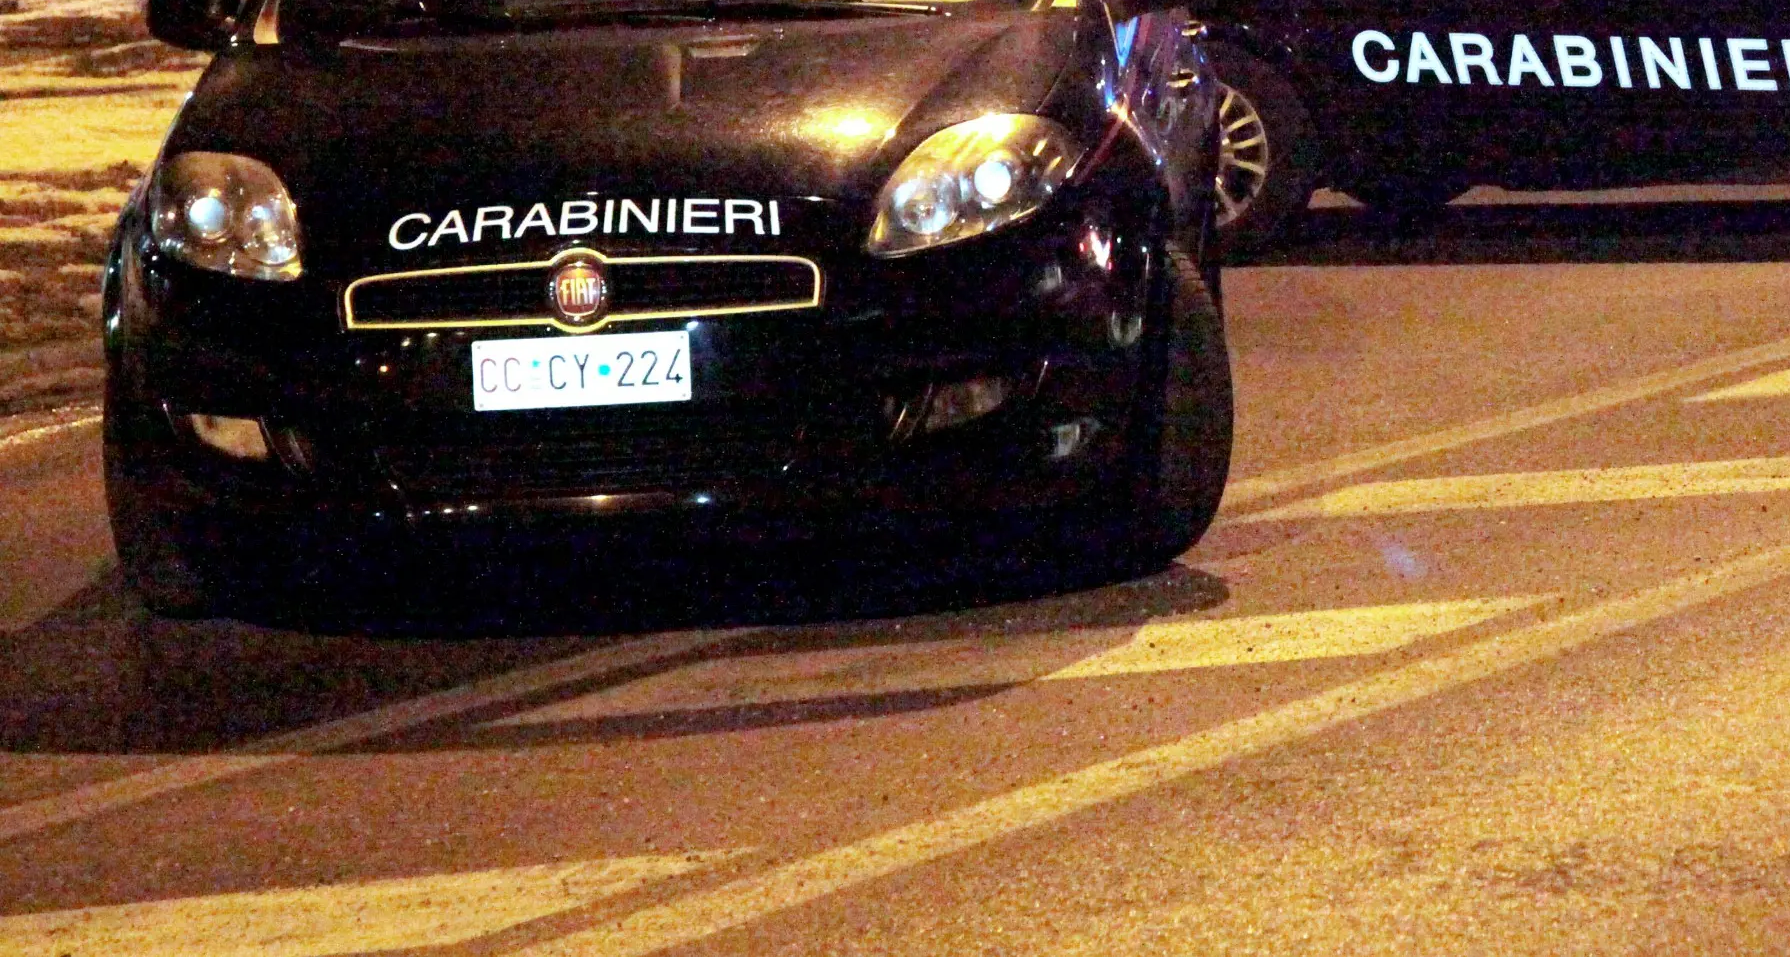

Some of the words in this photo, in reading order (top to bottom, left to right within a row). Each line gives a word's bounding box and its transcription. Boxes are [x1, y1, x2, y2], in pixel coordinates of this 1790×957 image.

[388, 198, 781, 250] CARABINIERI
[561, 276, 597, 306] FIAT
[615, 348, 684, 387] 224
